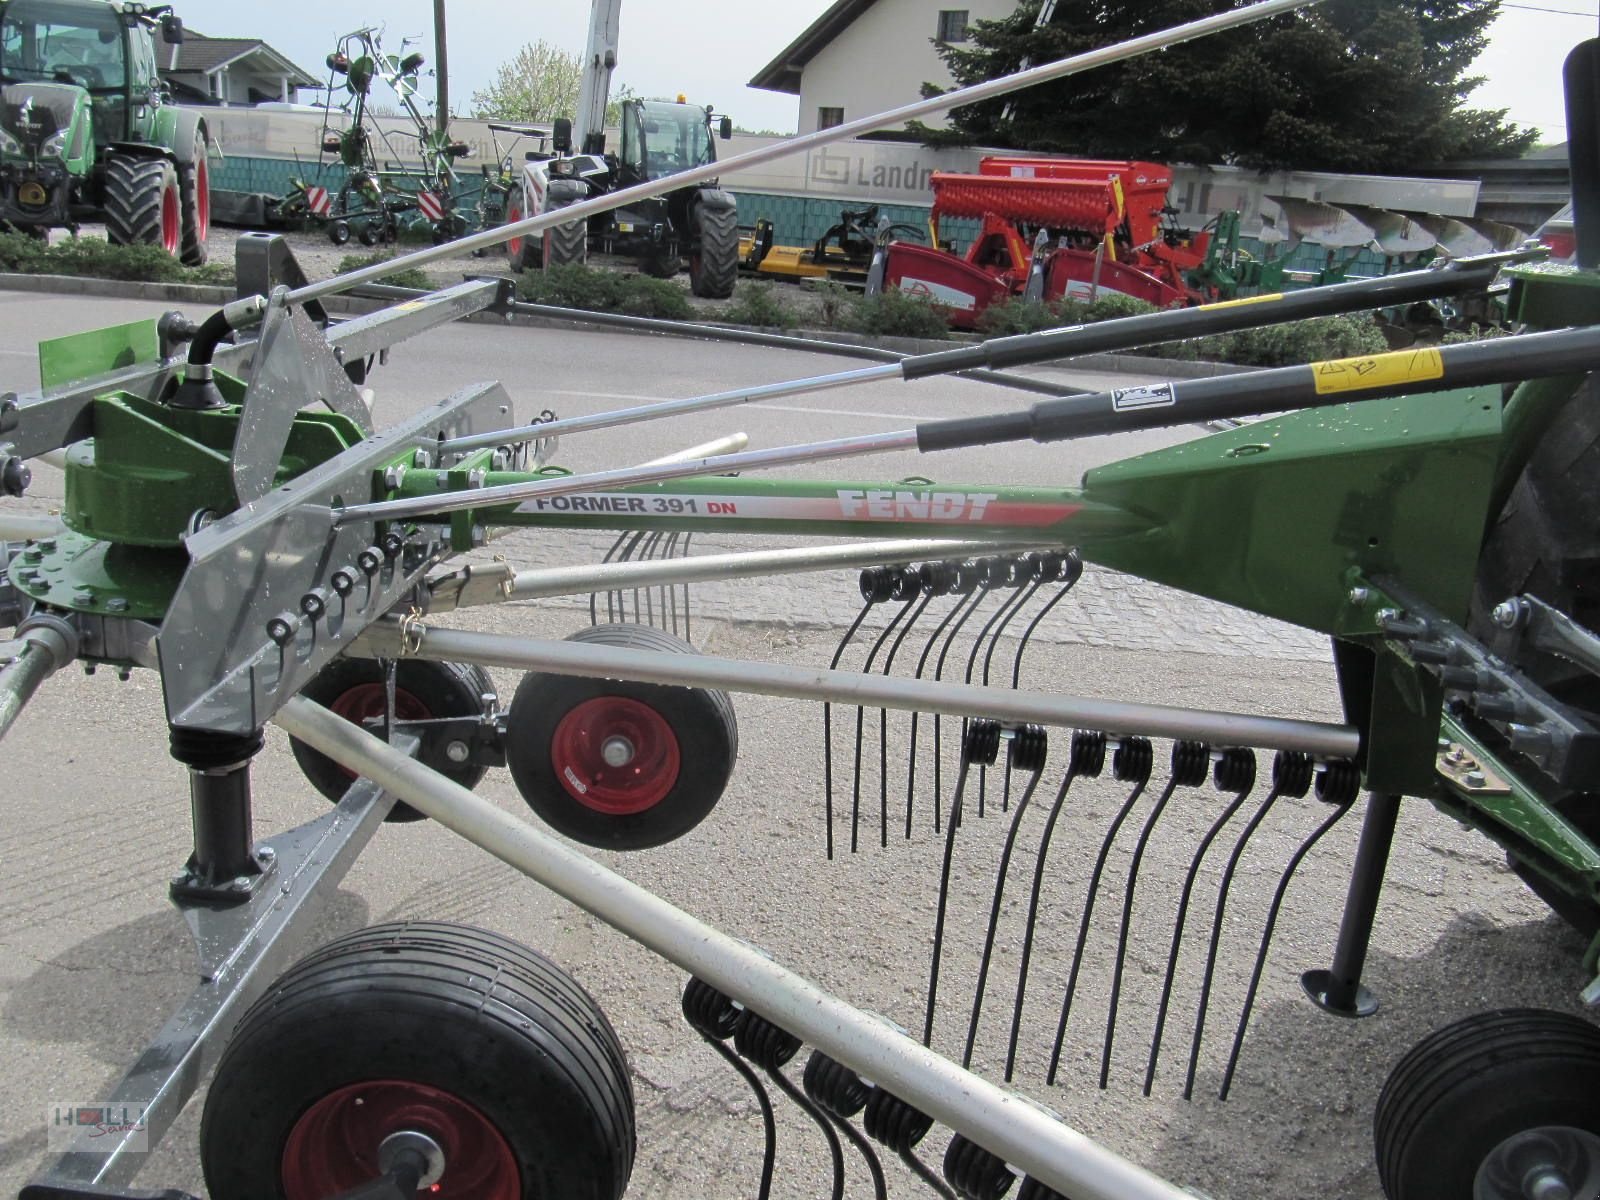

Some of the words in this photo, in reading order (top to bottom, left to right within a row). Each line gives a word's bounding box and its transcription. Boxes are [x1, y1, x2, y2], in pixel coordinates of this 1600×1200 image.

[536, 495, 647, 513] FORMER
[652, 497, 698, 514] 391
[706, 502, 737, 514] DN
[836, 489, 998, 521] FENDT
